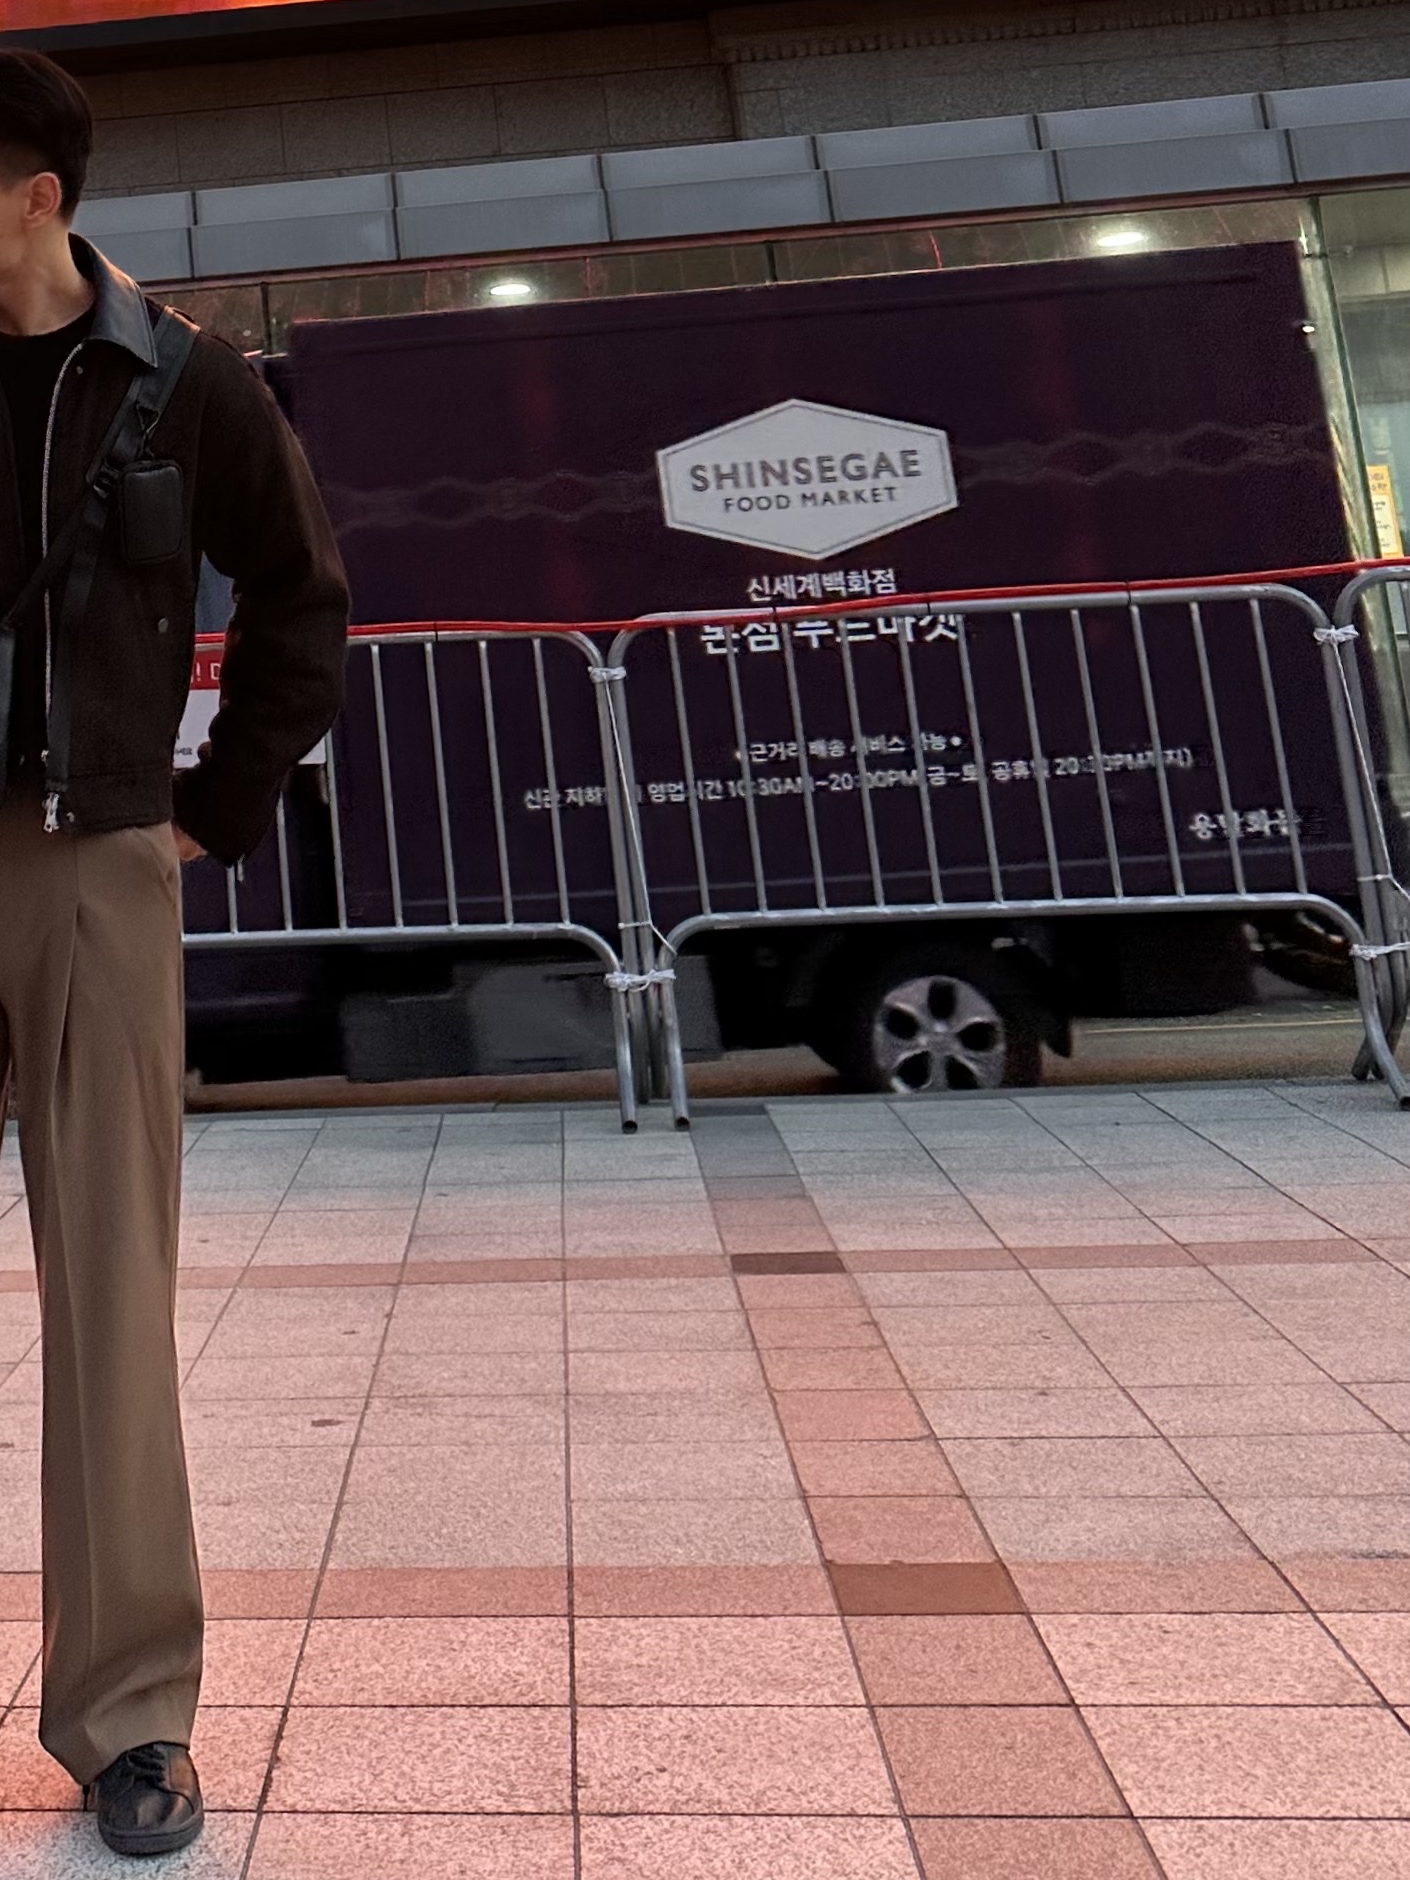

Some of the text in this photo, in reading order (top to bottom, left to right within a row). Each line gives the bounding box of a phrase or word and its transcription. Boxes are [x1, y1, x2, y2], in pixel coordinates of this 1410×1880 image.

[690, 449, 923, 493] SHINSEGAE
[723, 486, 898, 513] FOOD MARKET
[746, 568, 897, 603] 신세계백화점
